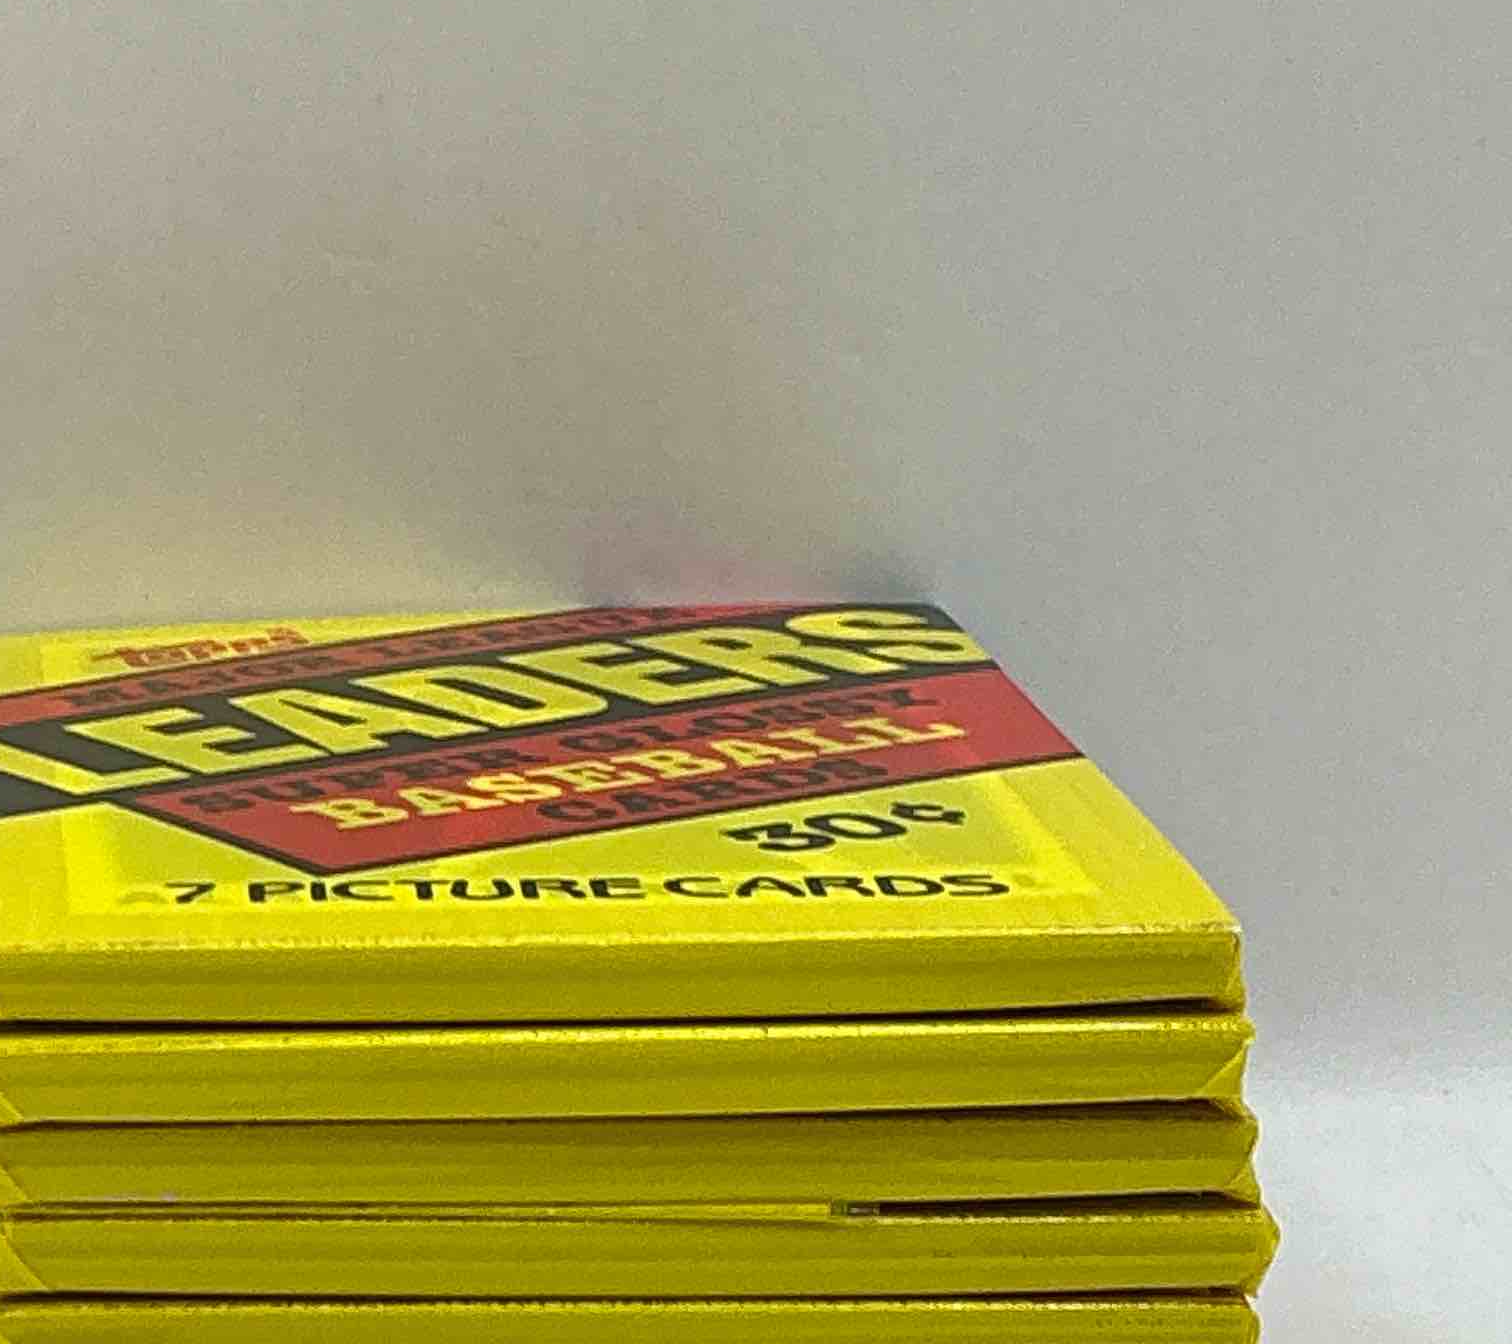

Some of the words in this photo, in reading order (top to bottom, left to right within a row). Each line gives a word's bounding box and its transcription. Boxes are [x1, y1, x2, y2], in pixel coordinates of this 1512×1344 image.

[178, 744, 535, 816] SUPER
[560, 685, 941, 754] GLOSSY
[288, 719, 966, 833] BASEBALL
[537, 757, 889, 824] CARDS
[721, 800, 966, 853] 30¢
[165, 880, 216, 905] 7
[248, 875, 648, 904] PICTURE
[663, 872, 1012, 901] CARDS
